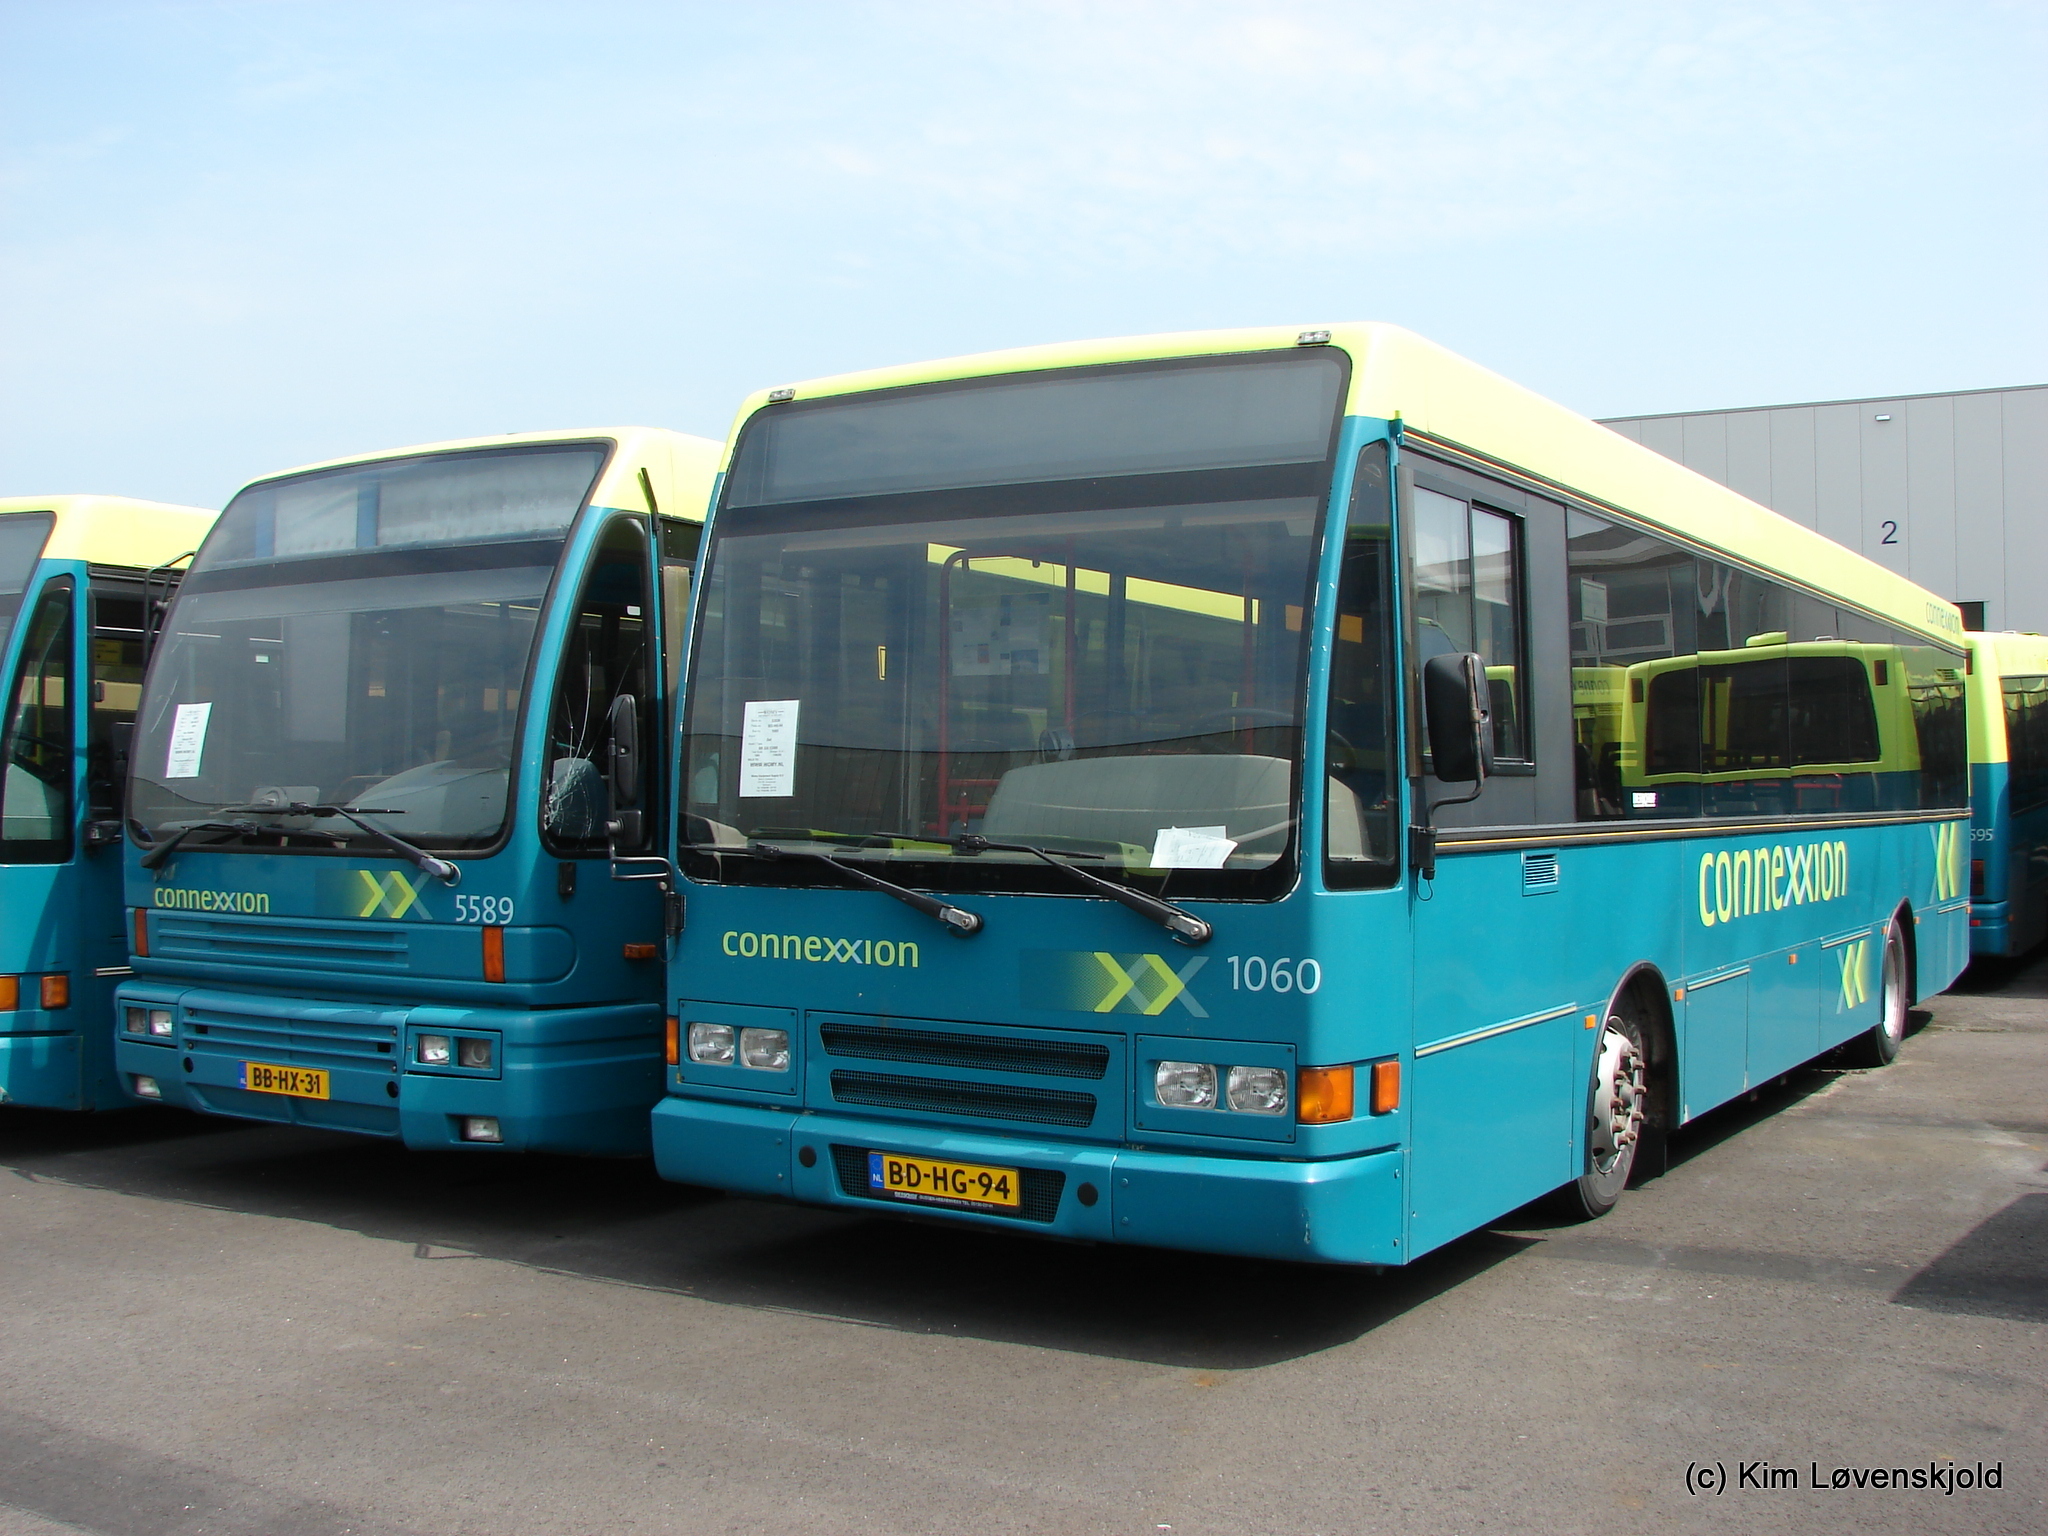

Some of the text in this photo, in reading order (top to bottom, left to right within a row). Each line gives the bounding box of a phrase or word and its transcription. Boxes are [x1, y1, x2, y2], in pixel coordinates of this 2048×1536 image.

[1881, 520, 1898, 545] 2
[154, 886, 270, 914] connexxion
[1699, 840, 1846, 927] connexxion
[455, 894, 514, 925] 5589
[722, 930, 919, 968] connexxion
[1227, 955, 1321, 995] 1060
[252, 1066, 321, 1095] BB-HX-31
[872, 1173, 884, 1183] NL
[888, 1160, 1011, 1200] BD-HG-94
